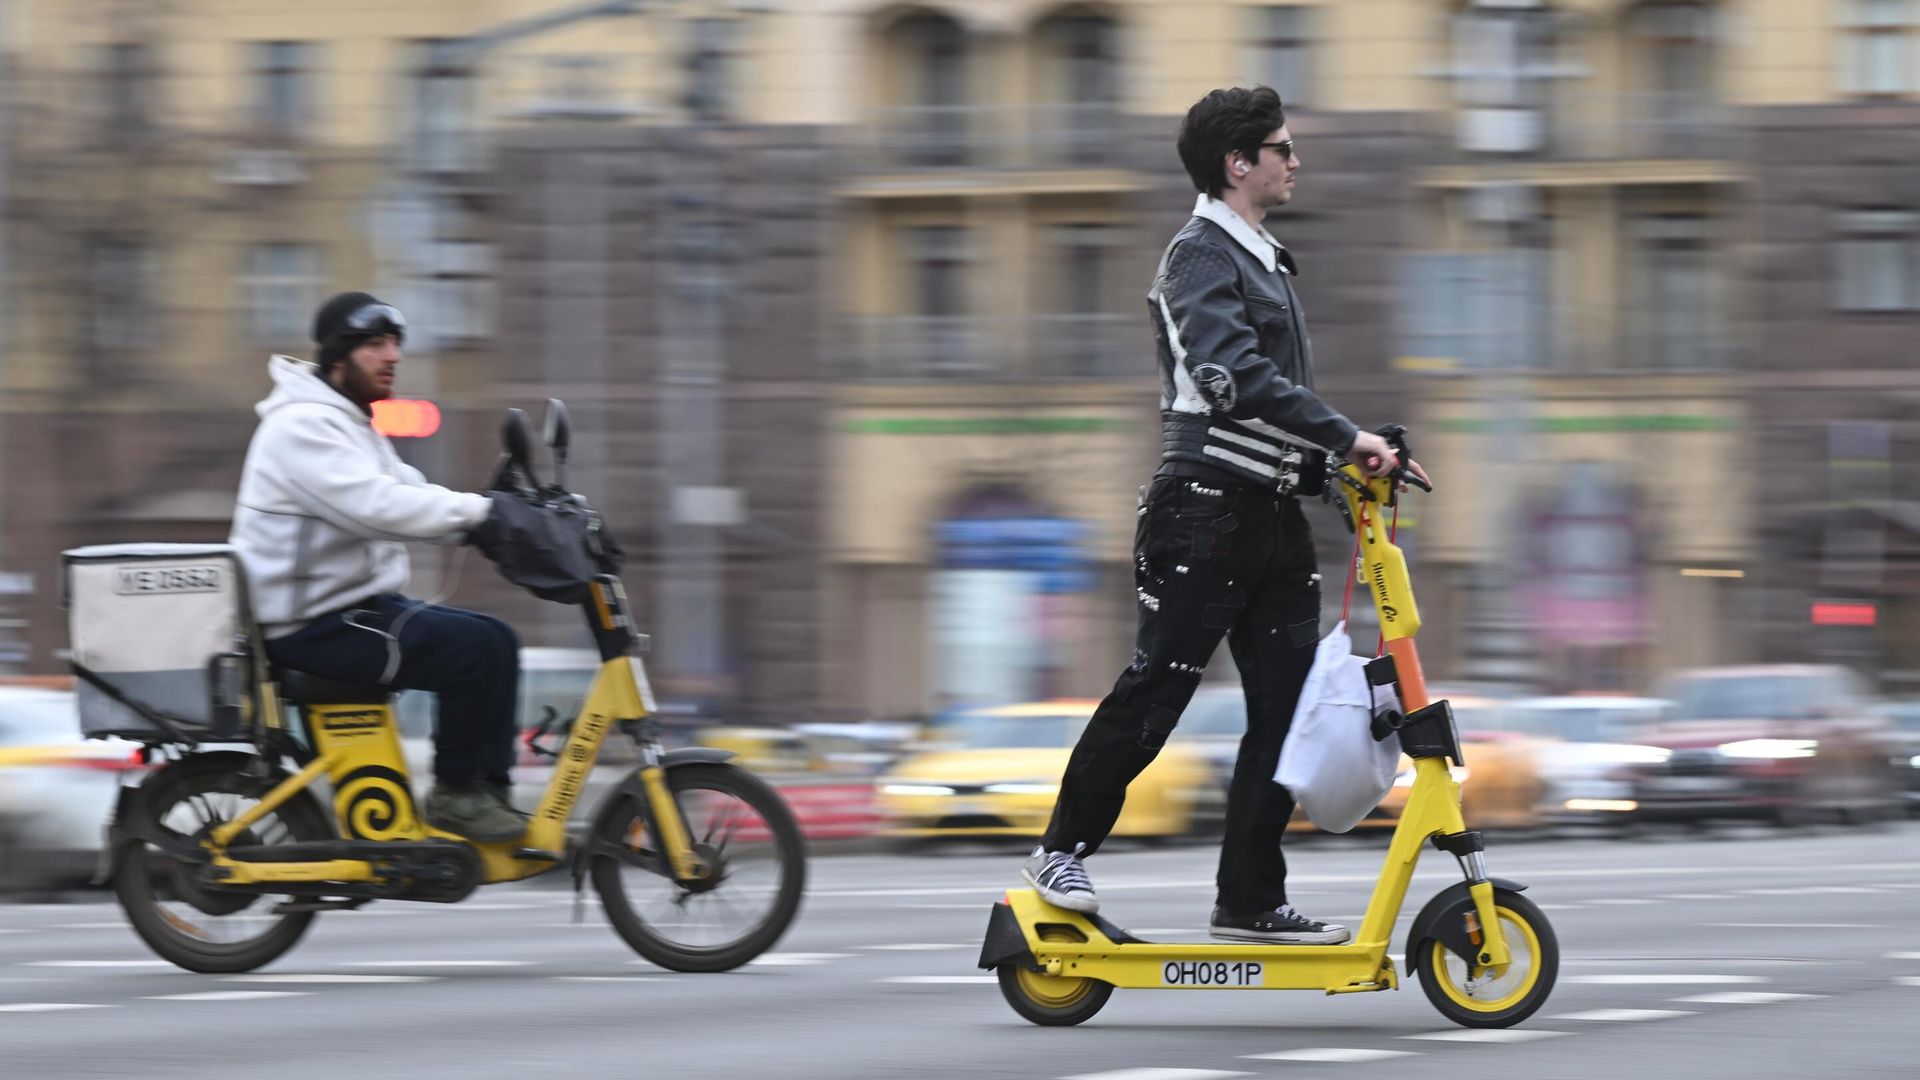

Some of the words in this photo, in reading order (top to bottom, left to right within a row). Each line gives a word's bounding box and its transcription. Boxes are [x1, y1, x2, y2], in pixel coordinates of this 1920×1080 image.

[1372, 562, 1389, 602] Яндекс
[1381, 605, 1398, 623] Go
[1165, 962, 1262, 985] OH081P
